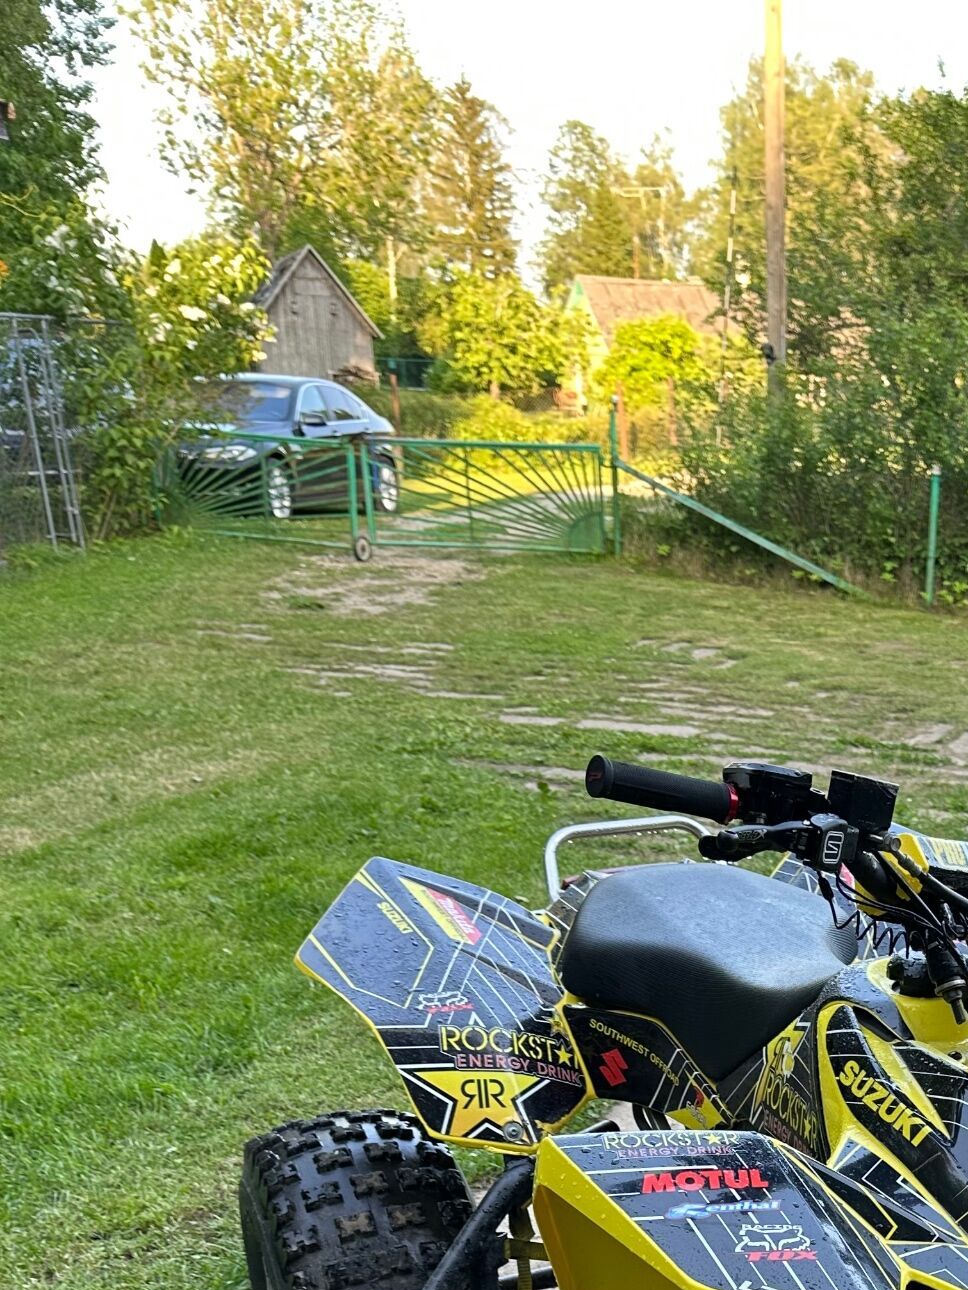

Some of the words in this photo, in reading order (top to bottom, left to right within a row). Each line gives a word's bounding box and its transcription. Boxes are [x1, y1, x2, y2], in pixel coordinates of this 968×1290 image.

[588, 1018, 650, 1057] SOUTHWEST
[649, 1052, 680, 1087] OFFROAD
[456, 1053, 530, 1071] ENERGY
[537, 1062, 582, 1083] DRINK
[839, 1060, 933, 1147] SUZUKI
[617, 1147, 682, 1158] ENERGY
[686, 1144, 735, 1156] DRINK
[640, 1168, 770, 1195] MOTUL
[746, 1250, 818, 1262] FOX
